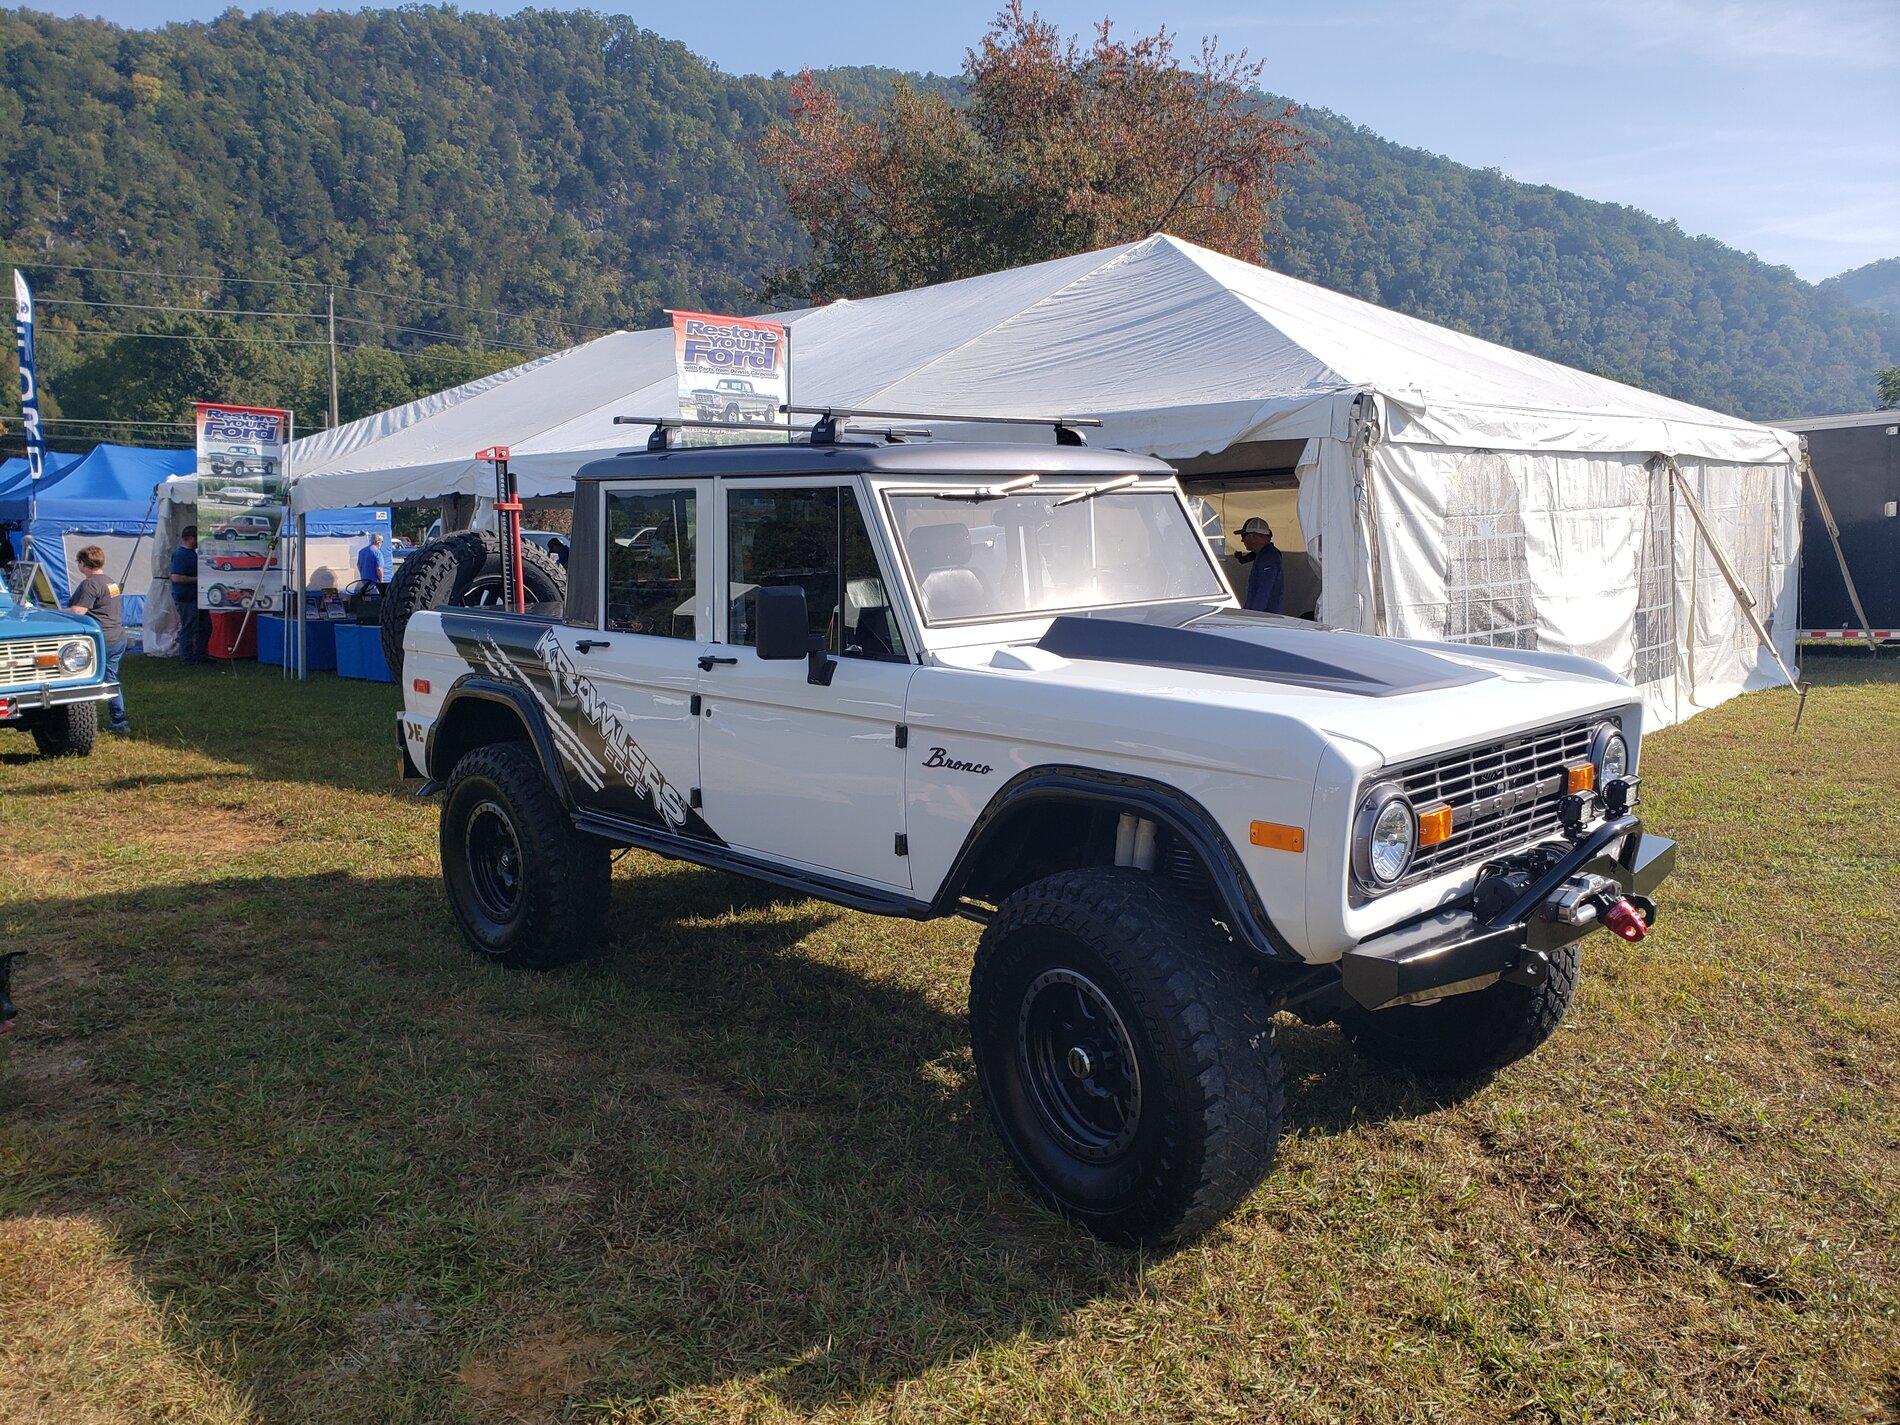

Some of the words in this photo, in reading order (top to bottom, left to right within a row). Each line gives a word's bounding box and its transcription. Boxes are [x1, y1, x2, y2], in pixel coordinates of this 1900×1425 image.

[686, 321, 777, 342] Restore
[684, 340, 775, 369] Ford
[708, 336, 765, 352] YOUR
[206, 408, 280, 424] Restore
[223, 418, 269, 432] YOUR
[203, 421, 276, 442] Ford
[534, 626, 687, 835] KRAWLERS
[922, 747, 993, 774] Bronco
[603, 748, 646, 801] EDGE
[1469, 783, 1545, 818] FORD
